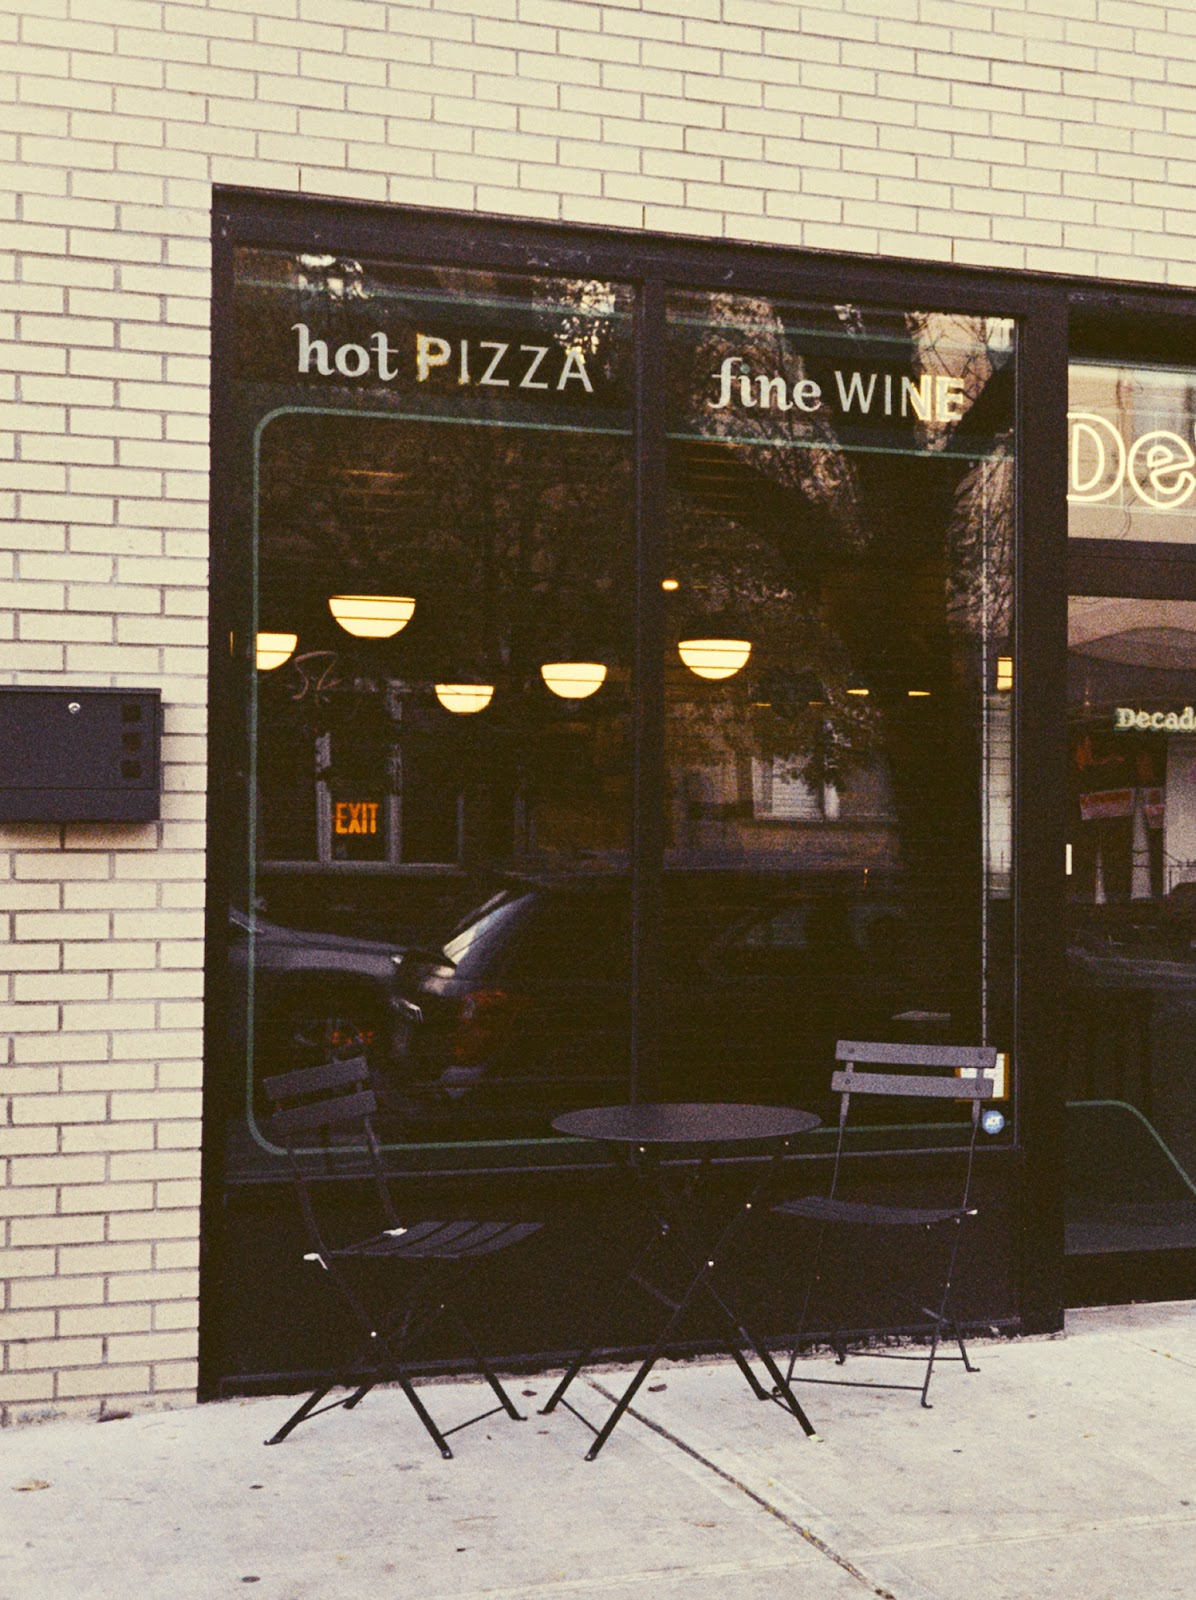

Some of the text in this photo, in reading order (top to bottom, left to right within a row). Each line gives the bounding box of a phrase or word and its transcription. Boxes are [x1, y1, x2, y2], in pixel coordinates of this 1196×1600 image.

[291, 322, 594, 393] hot PIZZA
[707, 356, 966, 423] fine WINE
[335, 802, 379, 834] EXIT
